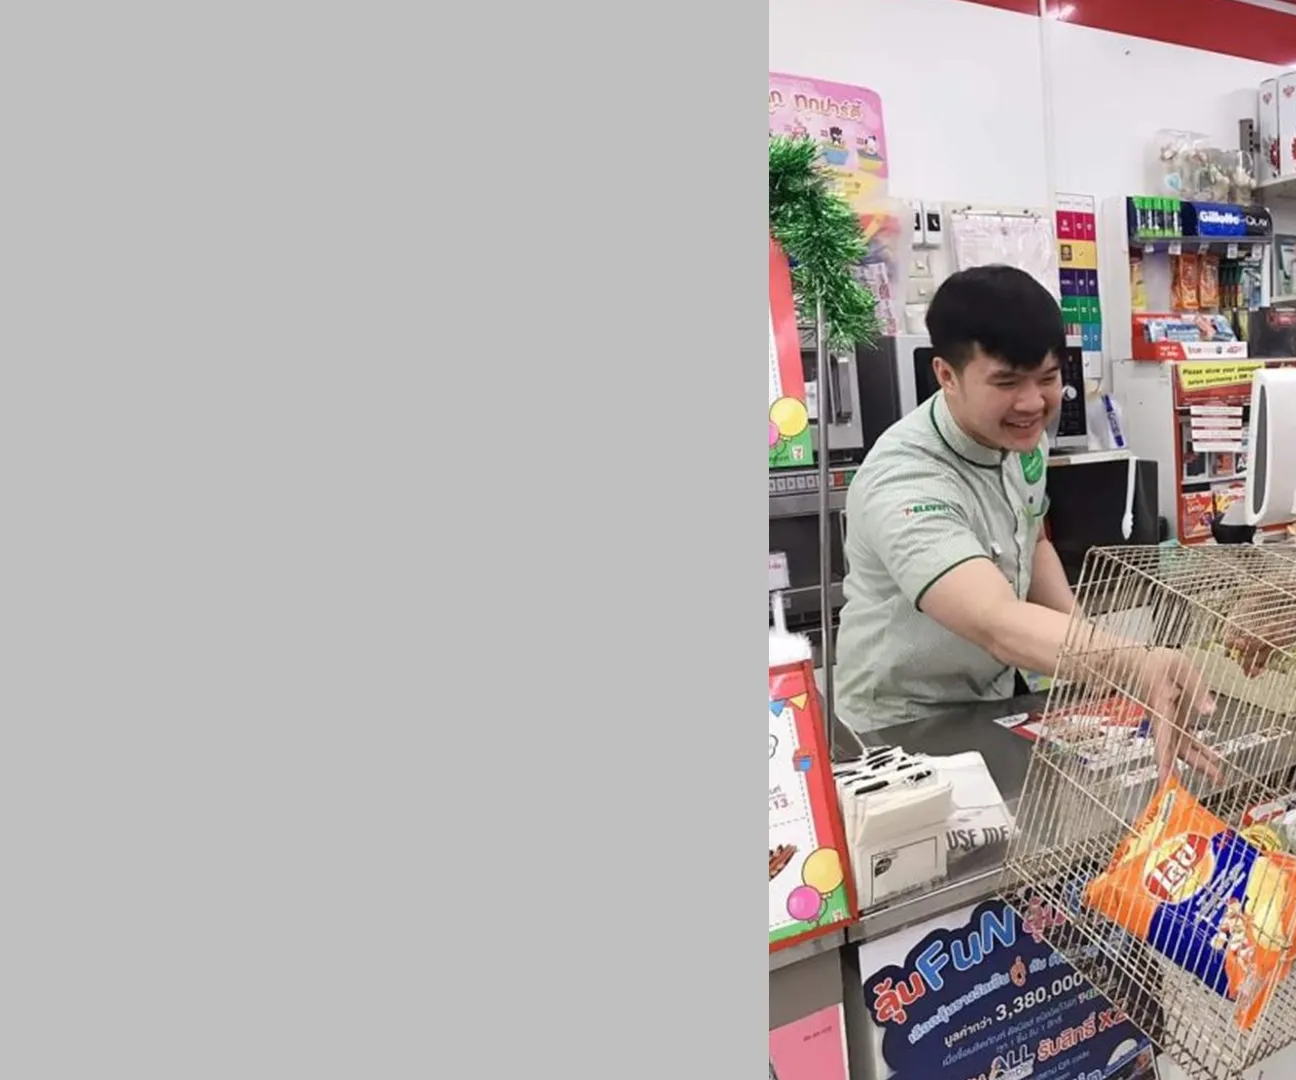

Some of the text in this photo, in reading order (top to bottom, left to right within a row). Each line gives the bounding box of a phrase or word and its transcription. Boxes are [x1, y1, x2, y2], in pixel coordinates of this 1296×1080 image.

[946, 829, 978, 851] USE
[874, 976, 926, 1024] ลุ้น
[995, 970, 1084, 1022] 3,380,000
